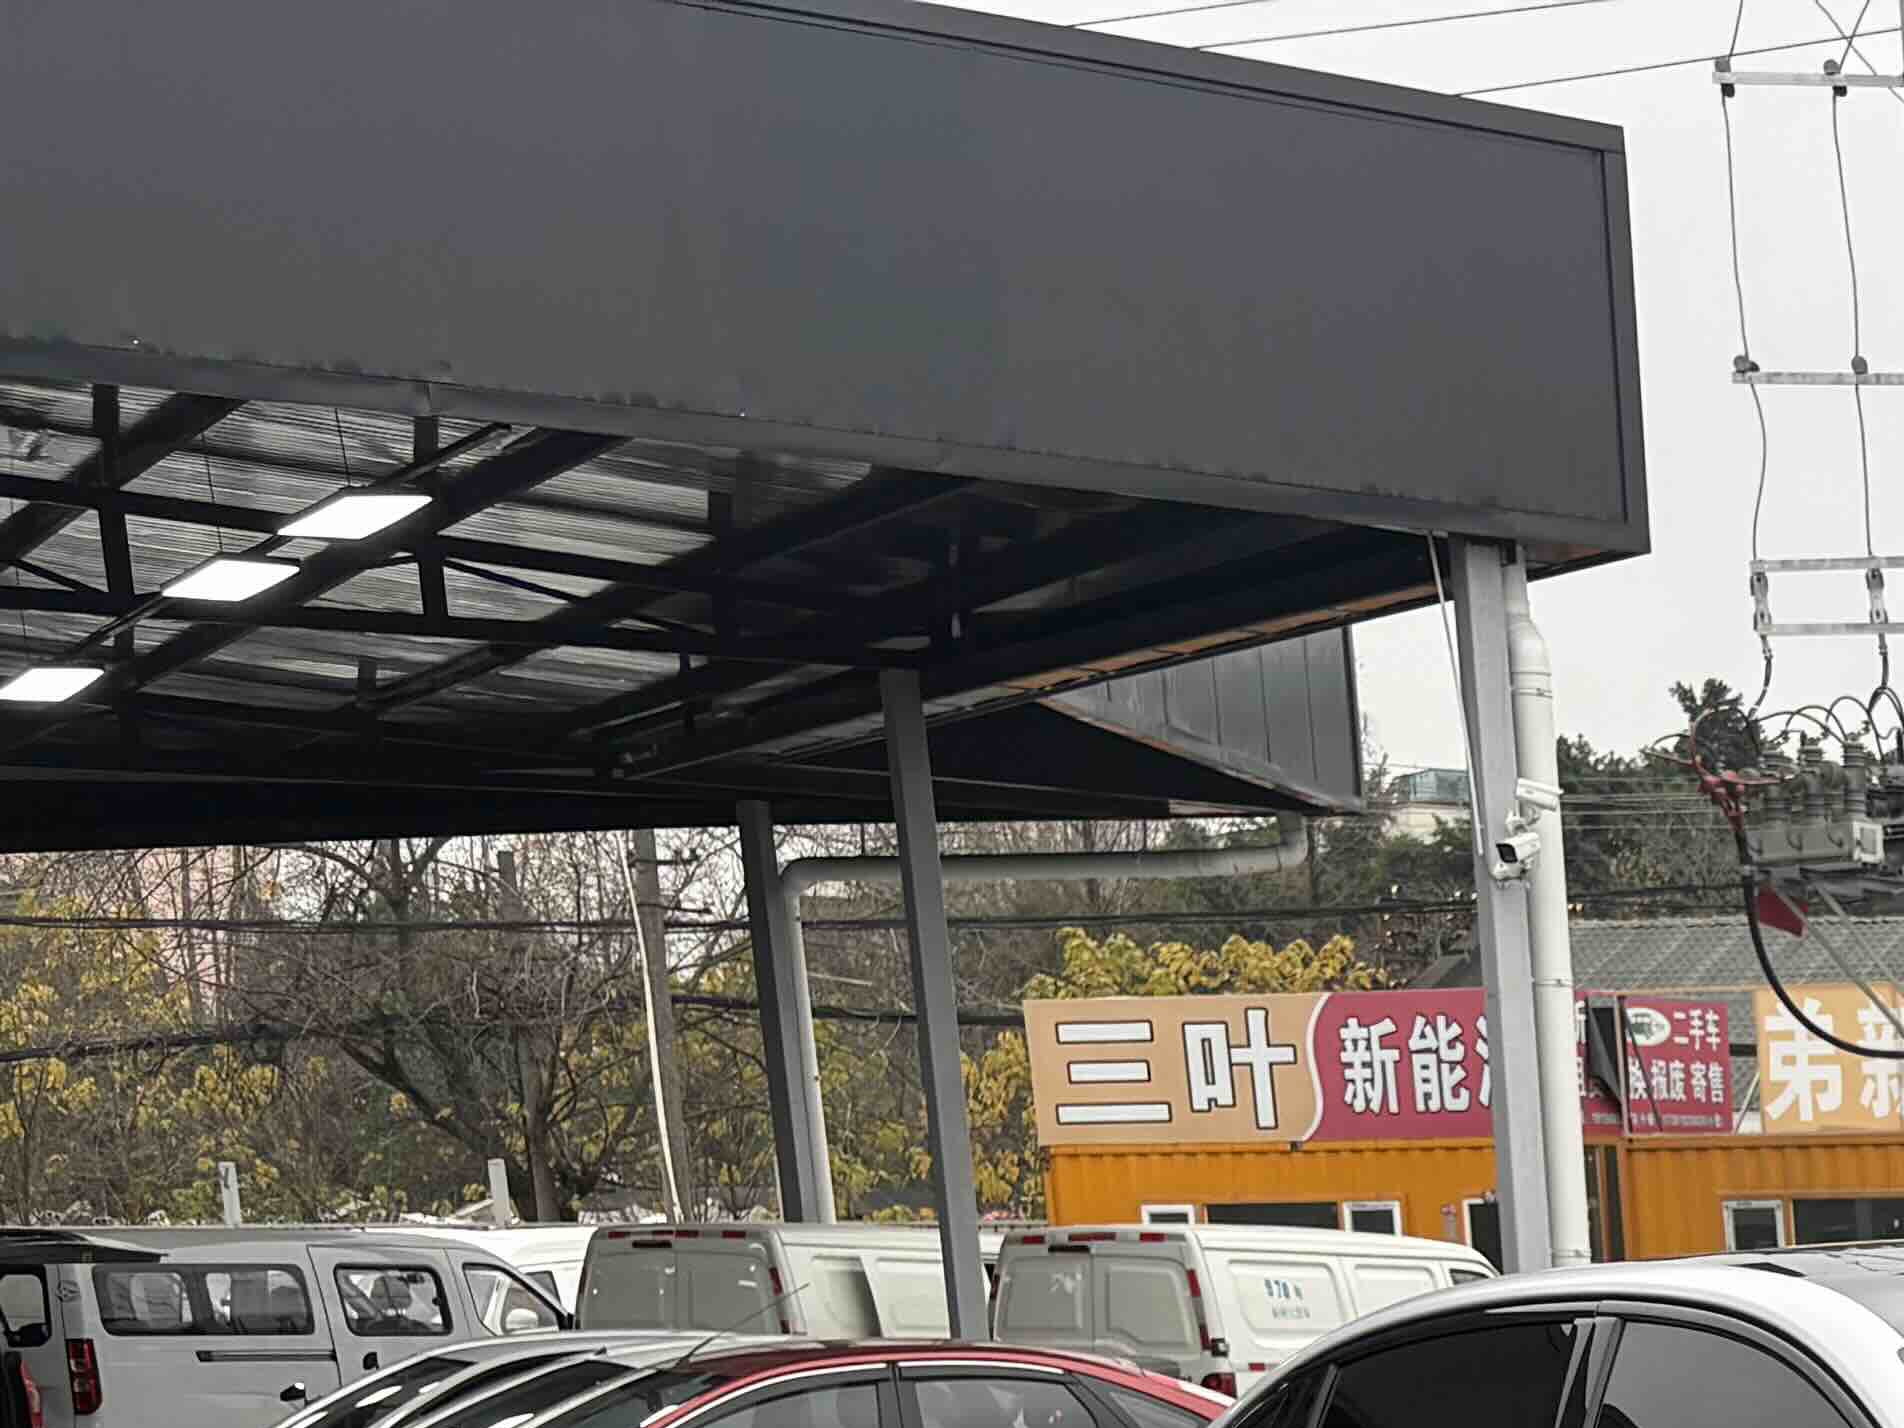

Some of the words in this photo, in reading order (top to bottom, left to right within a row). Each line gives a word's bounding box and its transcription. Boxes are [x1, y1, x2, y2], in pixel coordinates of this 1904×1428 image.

[1055, 1007, 1297, 1130] 三叶
[1672, 1008, 1721, 1052] 二手车
